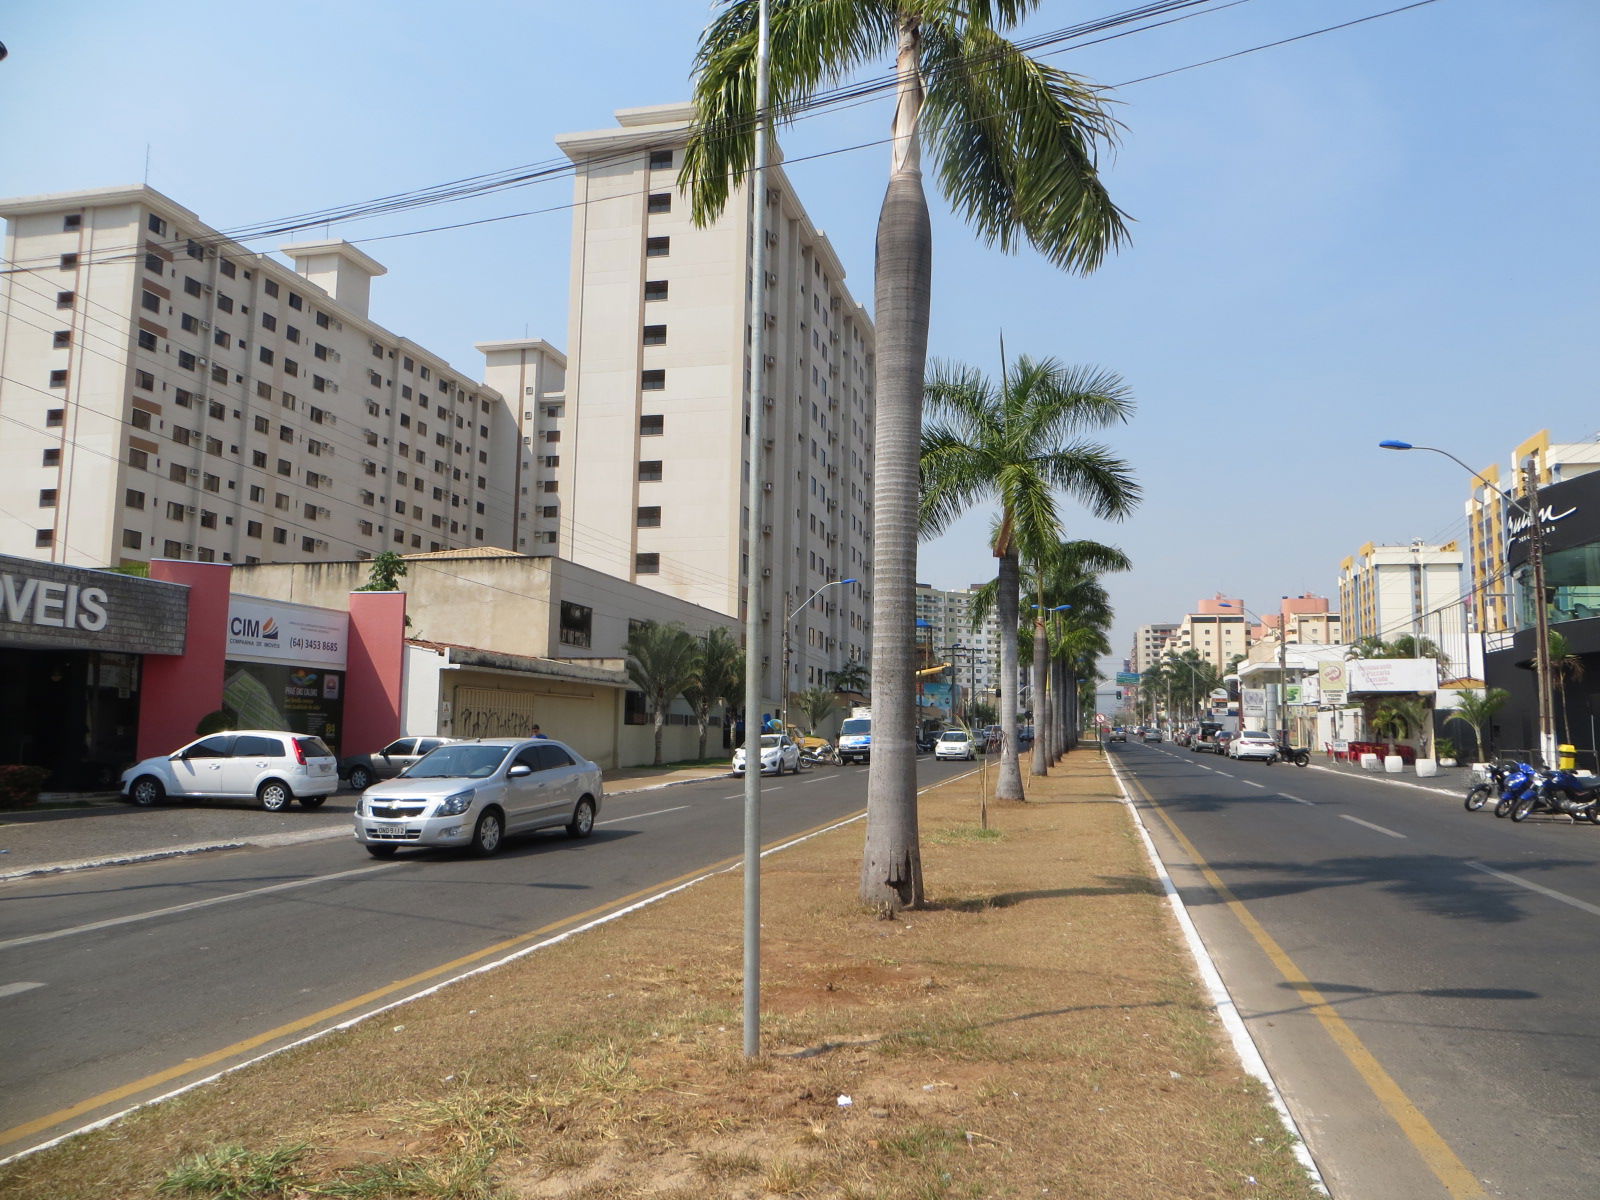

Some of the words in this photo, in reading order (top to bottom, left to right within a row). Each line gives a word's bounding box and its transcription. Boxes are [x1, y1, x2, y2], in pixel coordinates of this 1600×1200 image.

[0, 574, 108, 632] VEIS
[231, 616, 260, 638] CIM
[290, 636, 304, 650] (64)
[305, 639, 321, 651] 3453
